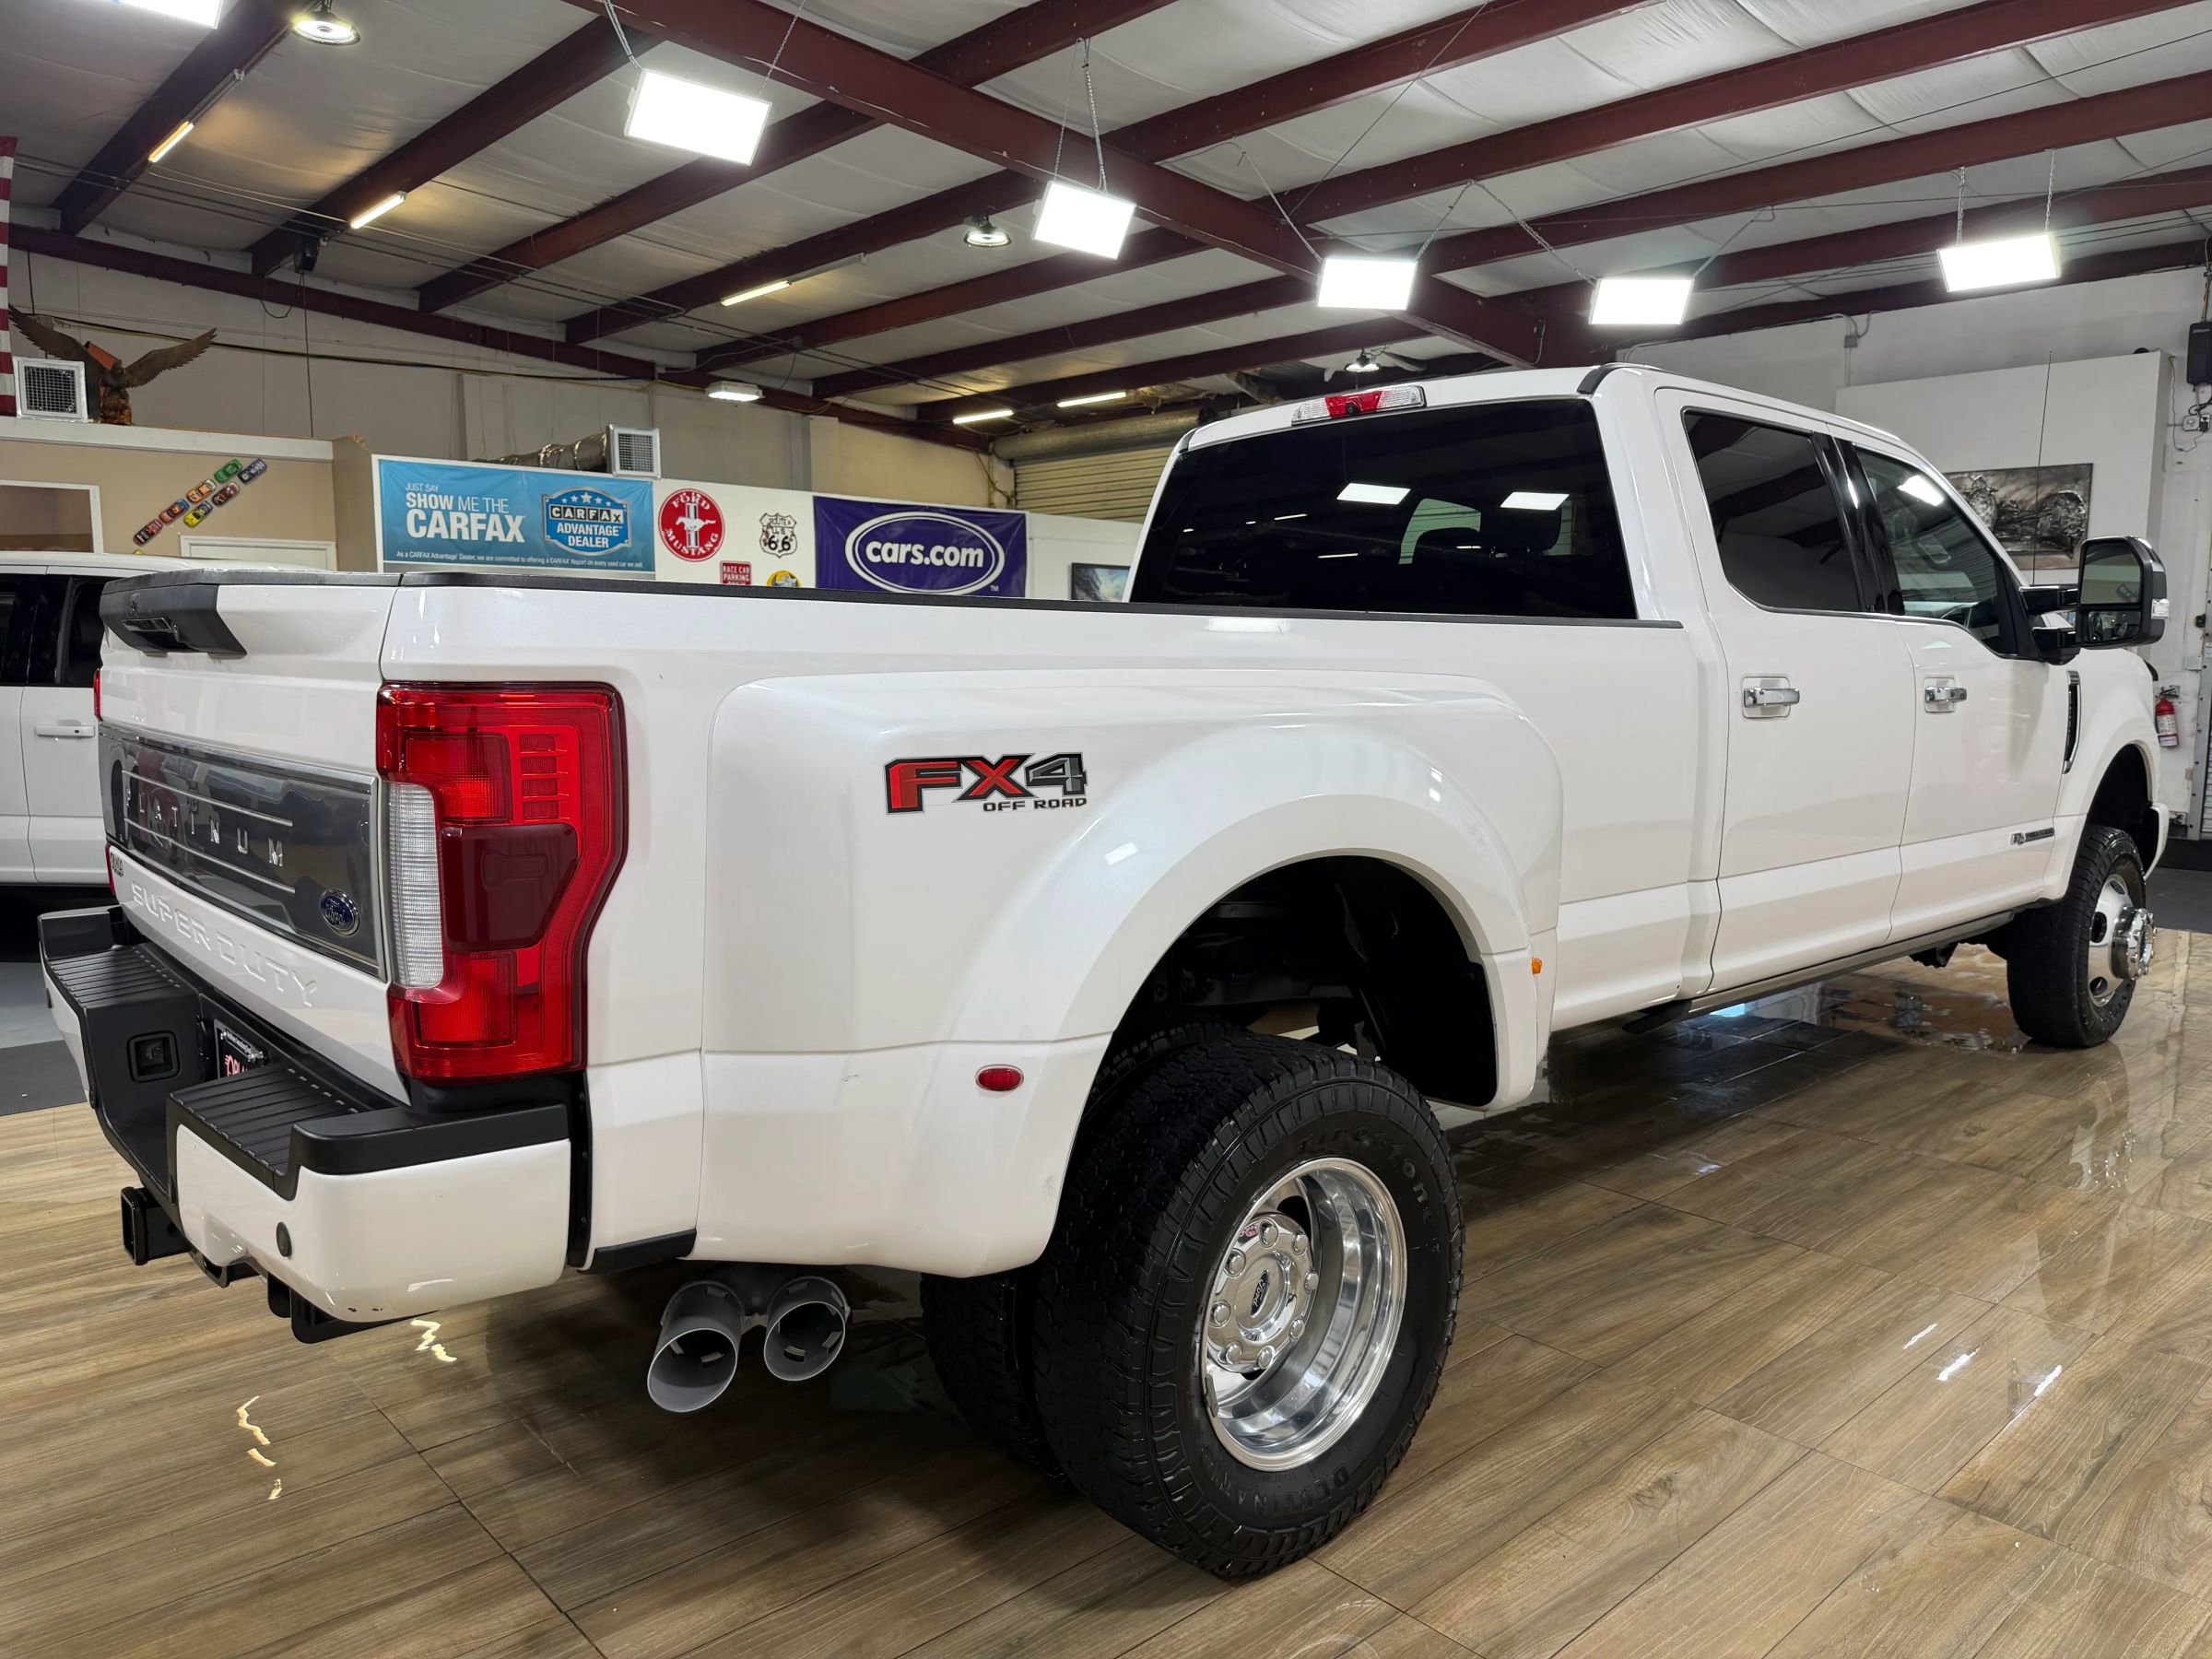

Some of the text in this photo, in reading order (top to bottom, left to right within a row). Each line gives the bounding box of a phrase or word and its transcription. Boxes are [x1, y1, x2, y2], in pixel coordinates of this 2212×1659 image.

[406, 483, 439, 492] JUST SAY
[406, 492, 509, 513] SHOW ME THE
[672, 491, 711, 510] FORD
[551, 507, 621, 523] CARFAX
[406, 509, 525, 543] CARFAX
[557, 523, 620, 536] ADVANTAGE
[568, 535, 609, 548] DEALER
[665, 528, 719, 556] MUSTANG
[768, 535, 791, 551] 66
[865, 540, 984, 568] cars.com
[723, 565, 750, 574] RACE CAR
[723, 573, 749, 582] PARKING
[884, 752, 1088, 814] FX4
[982, 797, 1088, 812] OFF ROAD
[125, 788, 284, 867] PLATINUM
[131, 881, 318, 1007] SUPER DUTY
